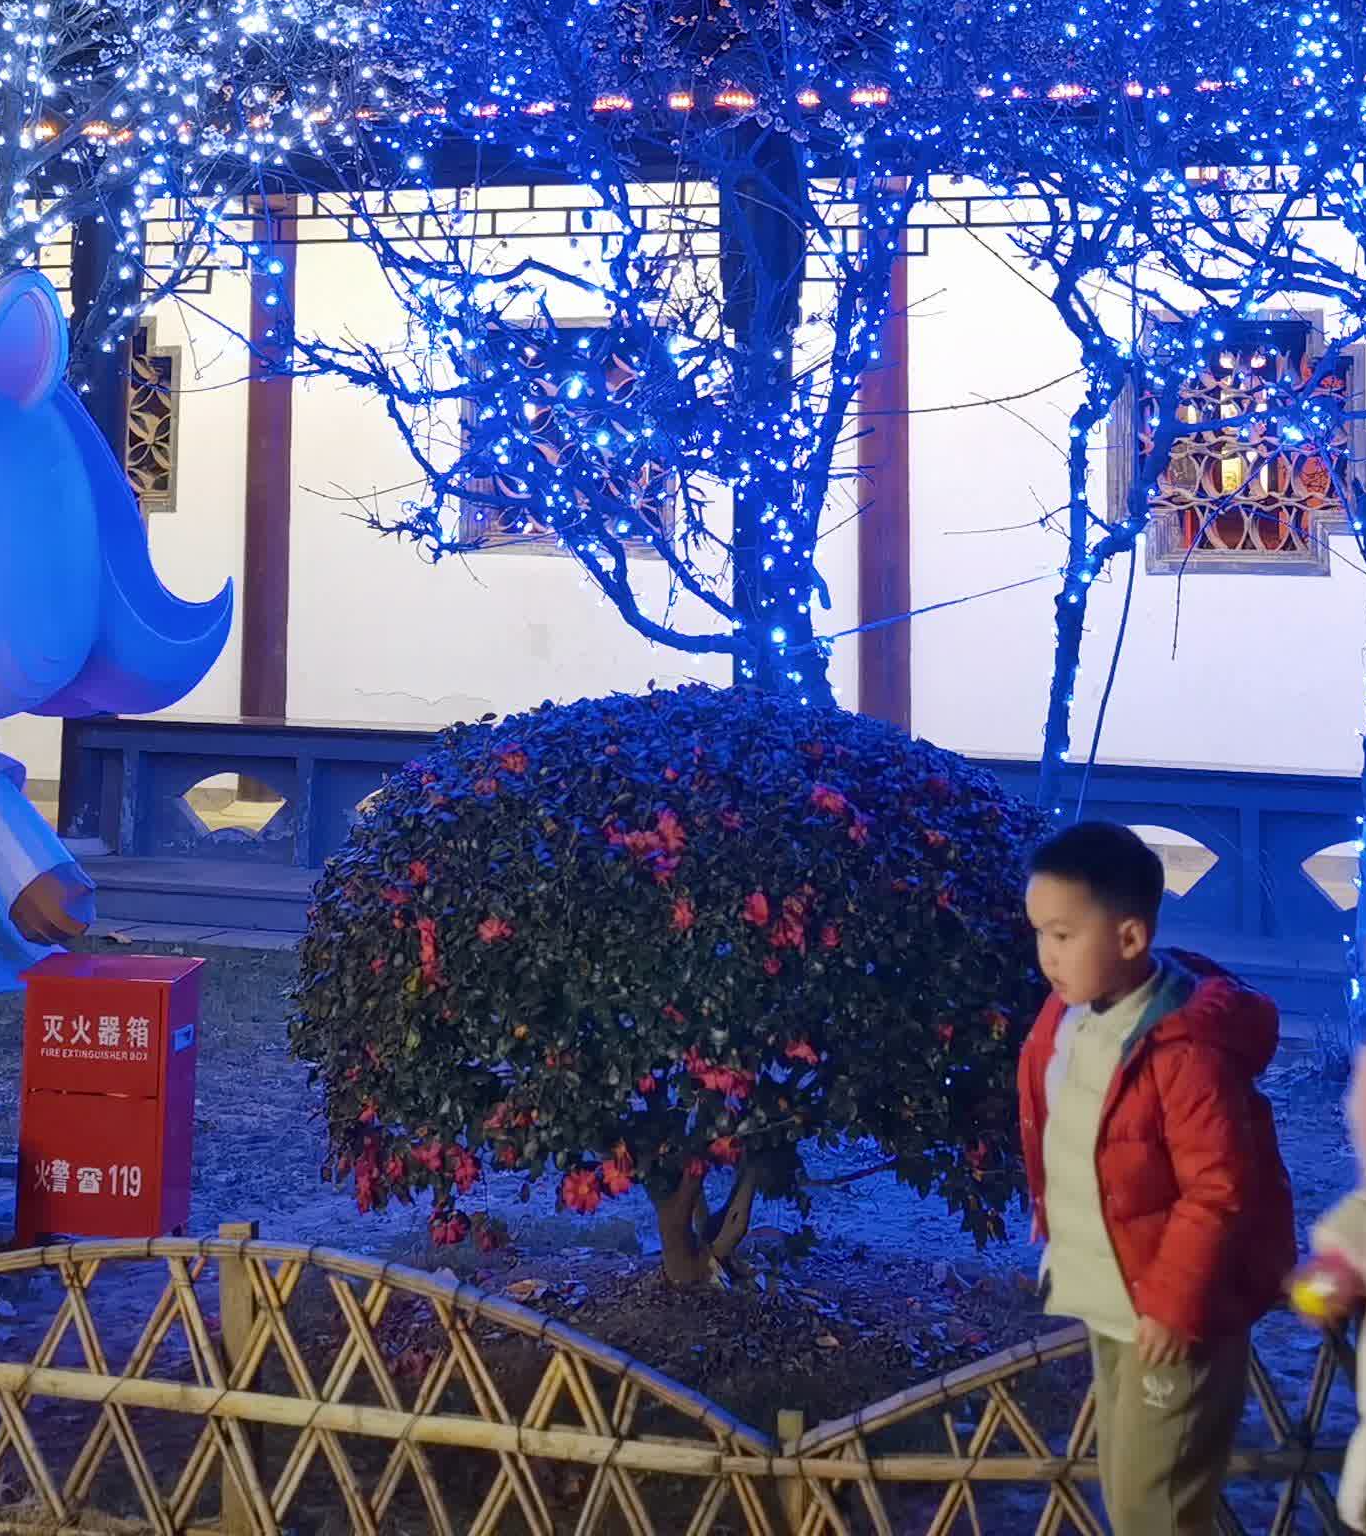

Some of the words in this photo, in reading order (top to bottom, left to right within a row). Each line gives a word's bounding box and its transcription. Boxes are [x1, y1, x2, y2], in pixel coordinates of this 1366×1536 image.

[42, 1014, 150, 1048] 灭火器箱
[40, 1047, 60, 1057] FIRE
[62, 1048, 128, 1061] EXTINGUISHER
[129, 1051, 148, 1062] BOX
[34, 1159, 71, 1194] 火警
[108, 1163, 142, 1197] 119
